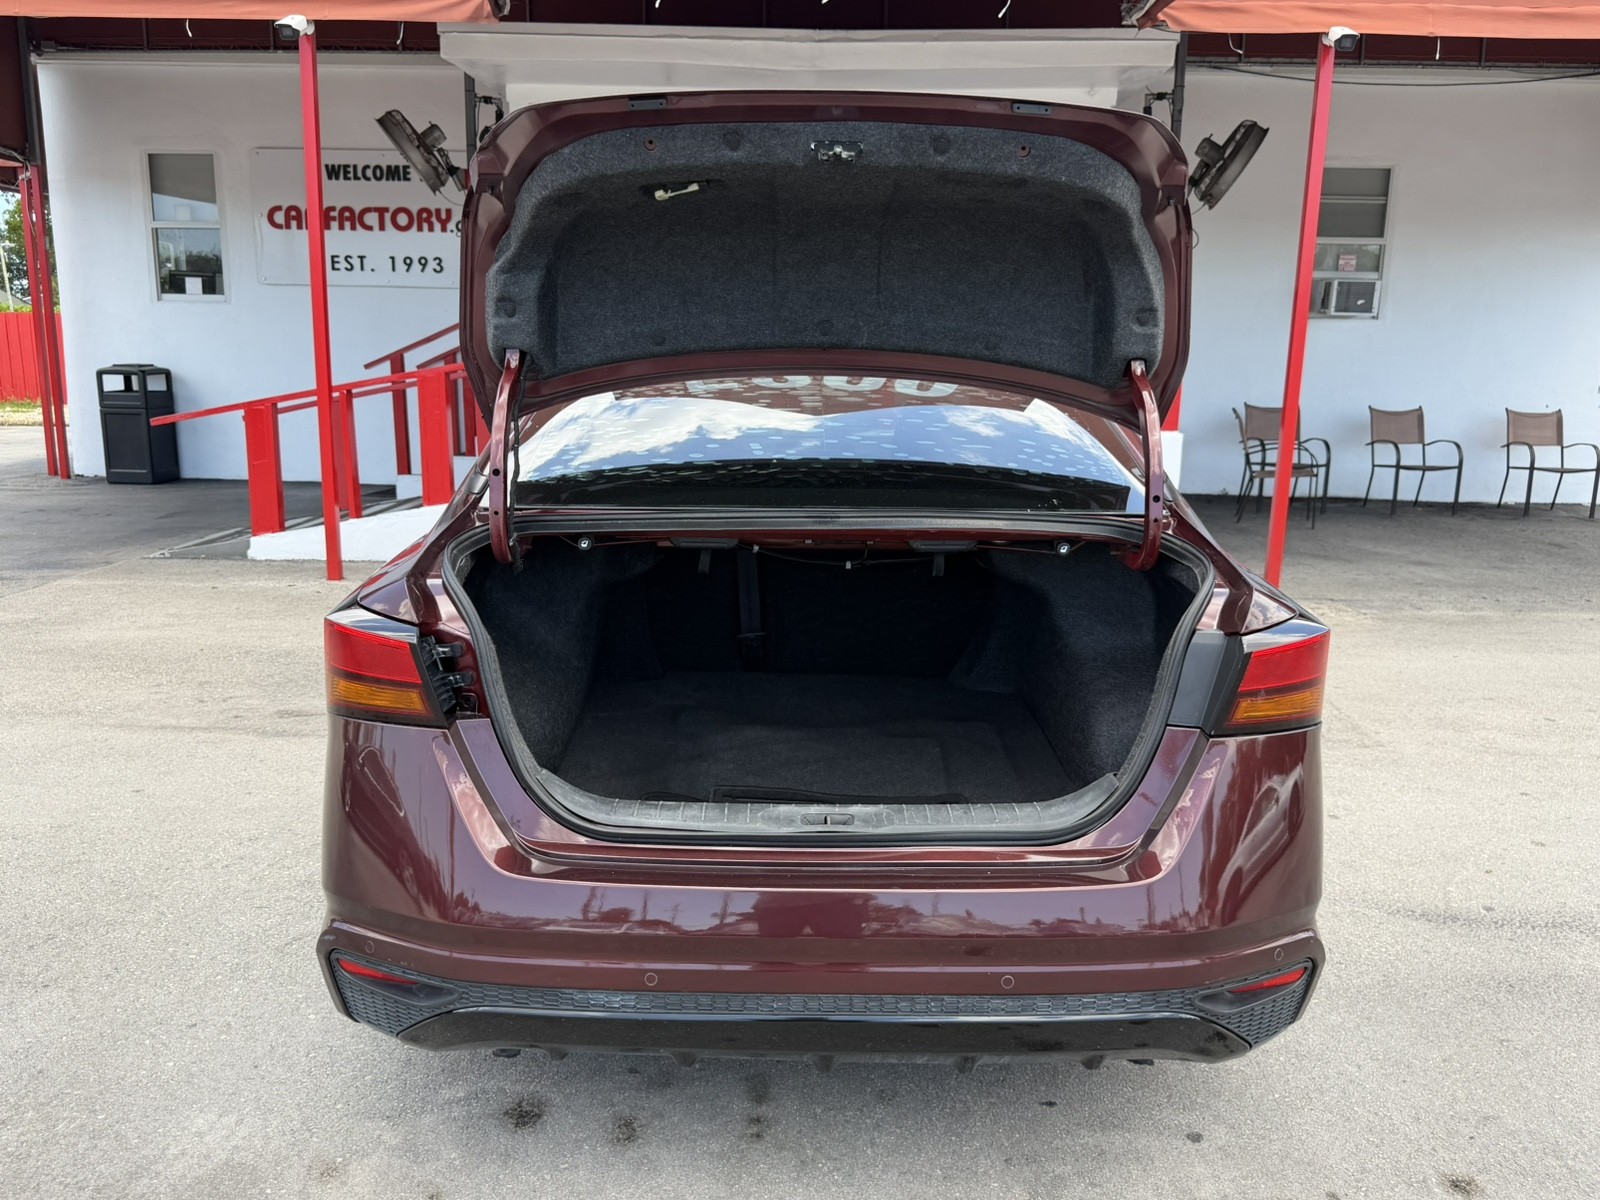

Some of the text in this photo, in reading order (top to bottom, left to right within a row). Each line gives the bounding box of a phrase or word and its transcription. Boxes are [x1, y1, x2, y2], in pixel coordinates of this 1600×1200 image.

[325, 163, 412, 182] WELCOME
[330, 254, 445, 274] EST. 1993
